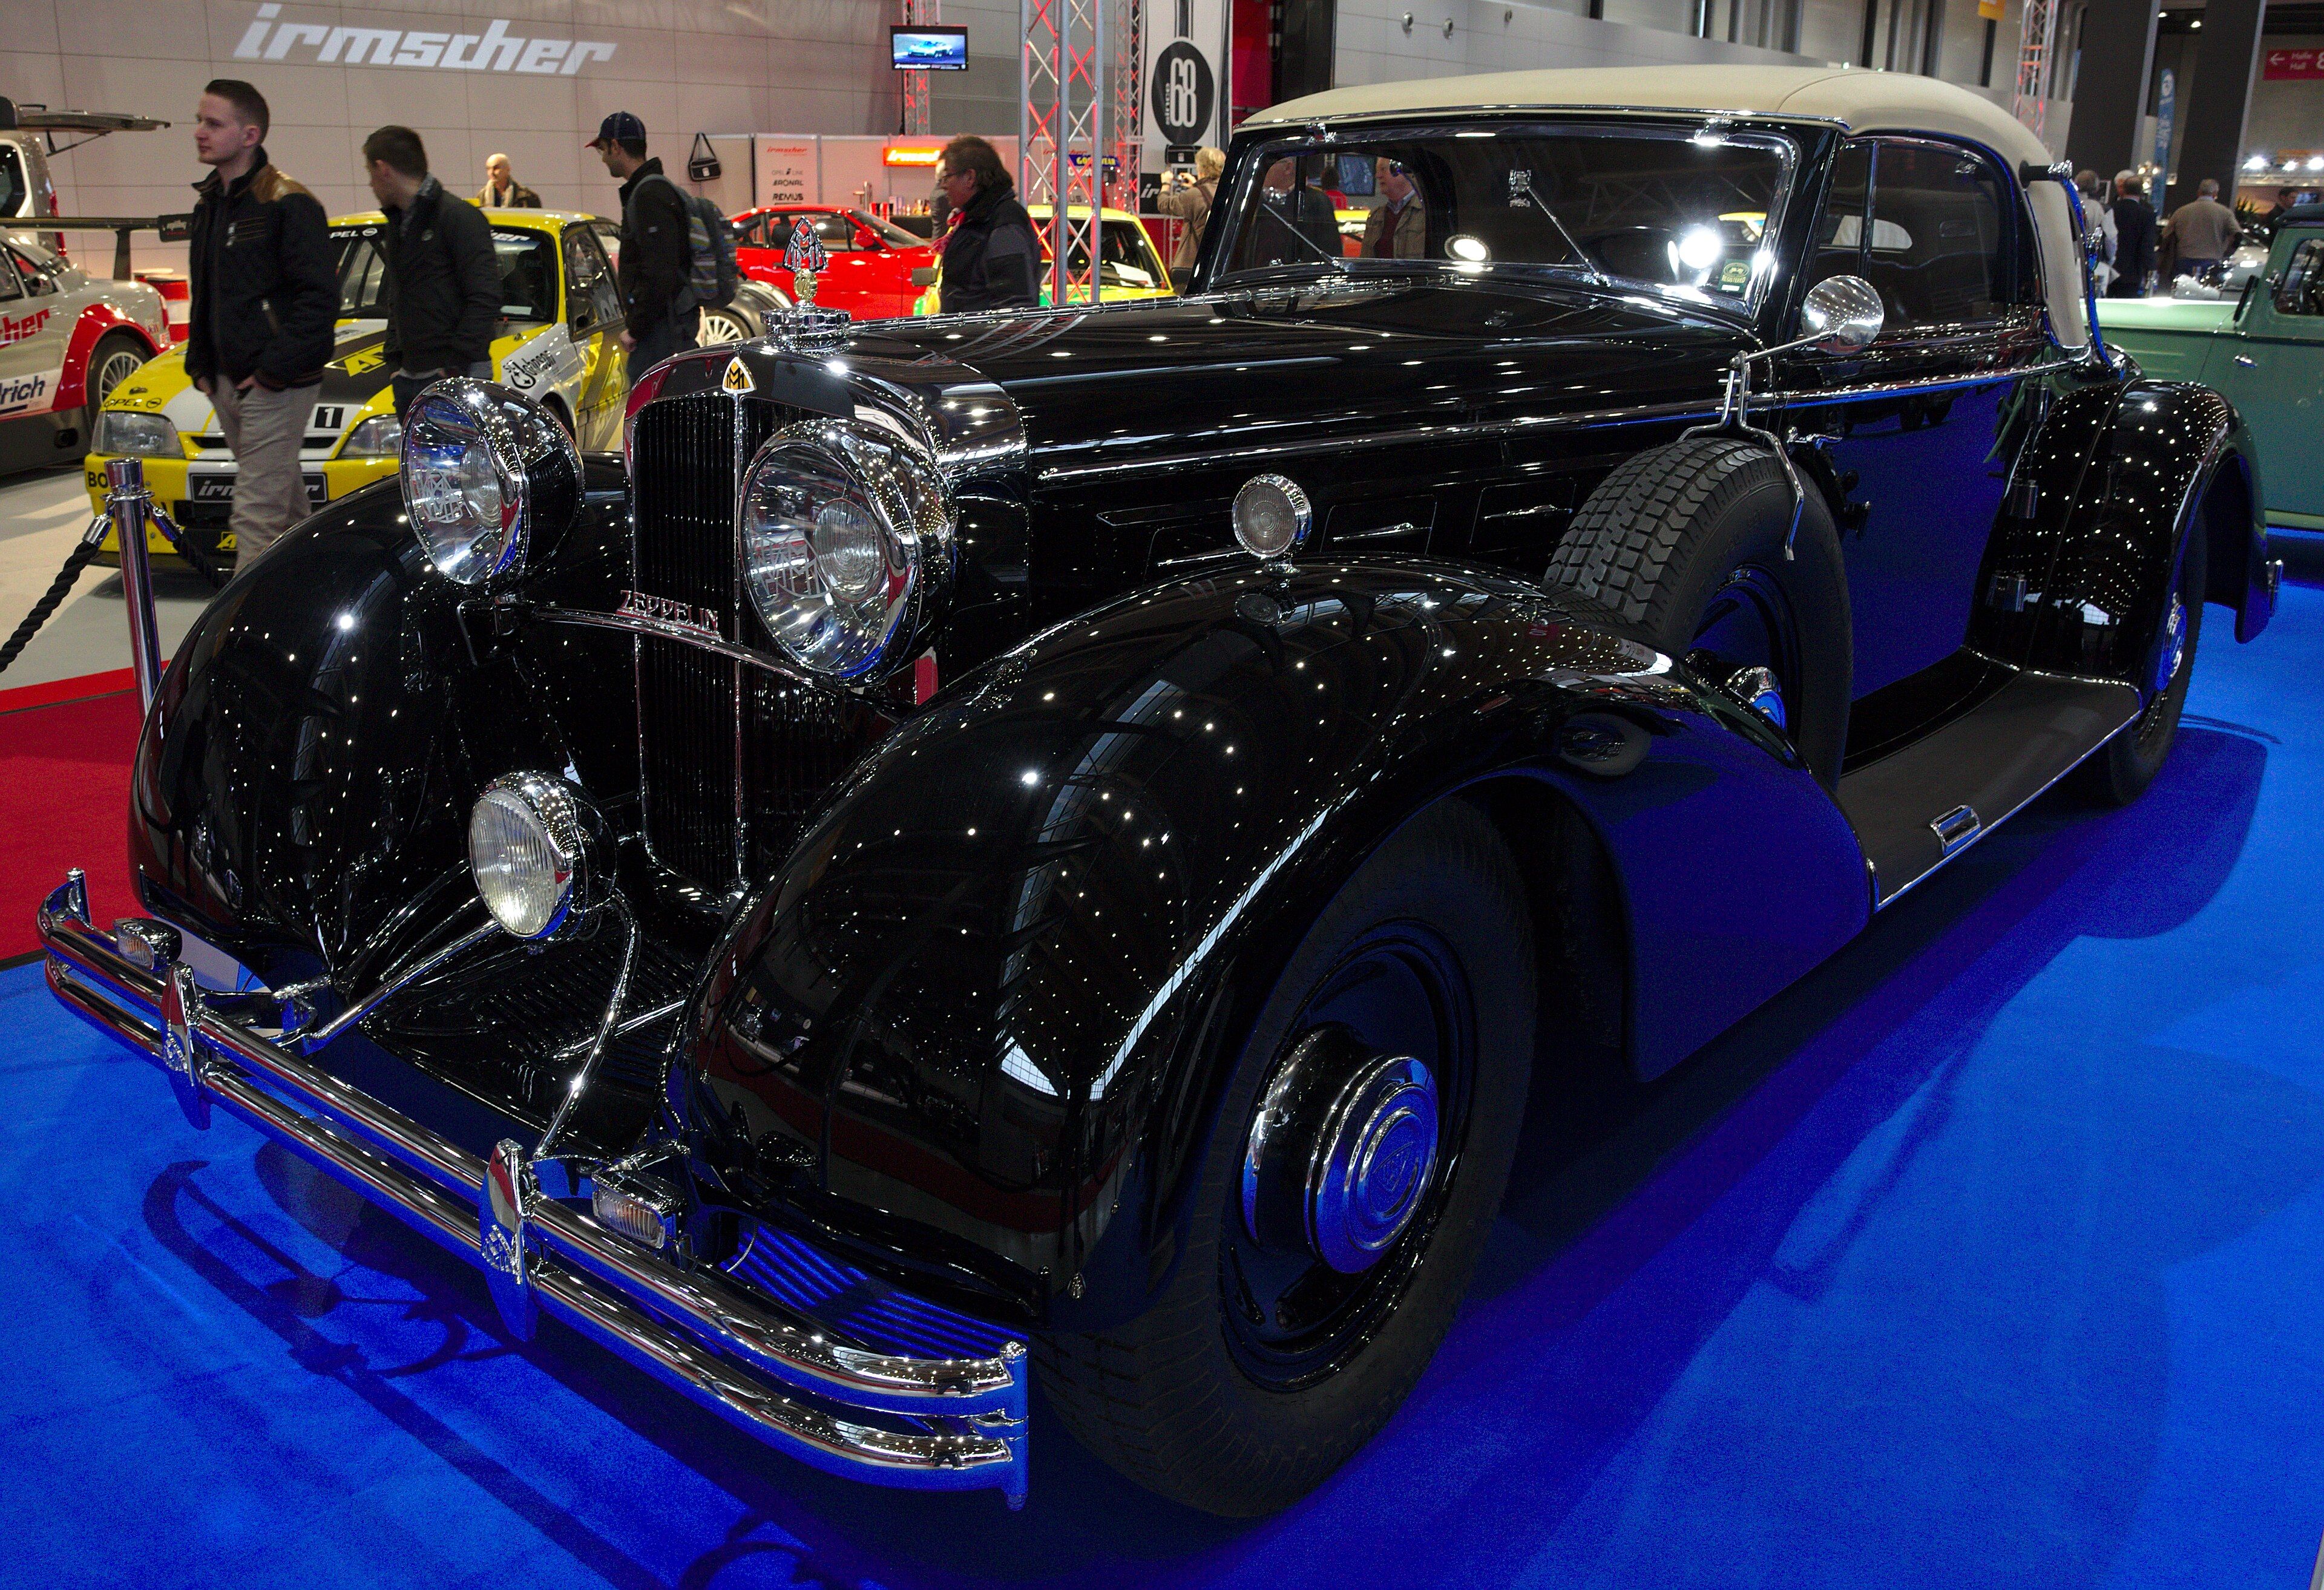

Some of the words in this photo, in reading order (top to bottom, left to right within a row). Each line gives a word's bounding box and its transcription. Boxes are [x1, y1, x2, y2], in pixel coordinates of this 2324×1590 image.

[234, 2, 617, 75] irmscher
[1170, 57, 1197, 128] 68
[330, 230, 358, 239] PEL
[324, 407, 335, 427] 1
[88, 471, 108, 488] BO
